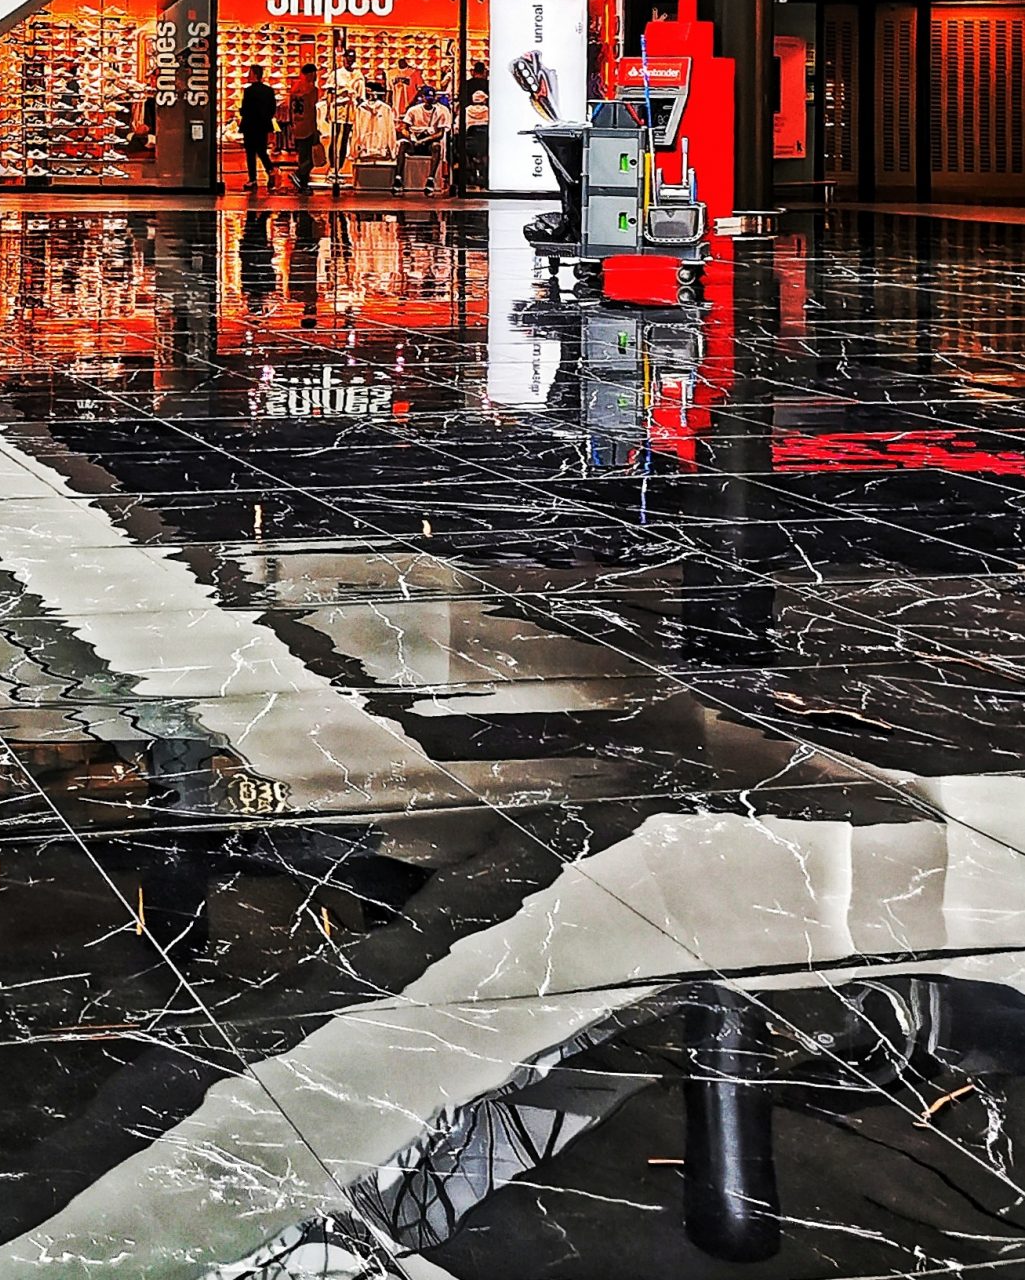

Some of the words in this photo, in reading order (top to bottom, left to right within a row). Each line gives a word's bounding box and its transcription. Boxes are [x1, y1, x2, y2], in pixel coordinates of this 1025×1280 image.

[532, 4, 543, 43] unreal
[156, 21, 180, 107] snipes
[187, 22, 211, 107] snipes
[638, 68, 680, 77] Sntander
[532, 155, 543, 178] feel
